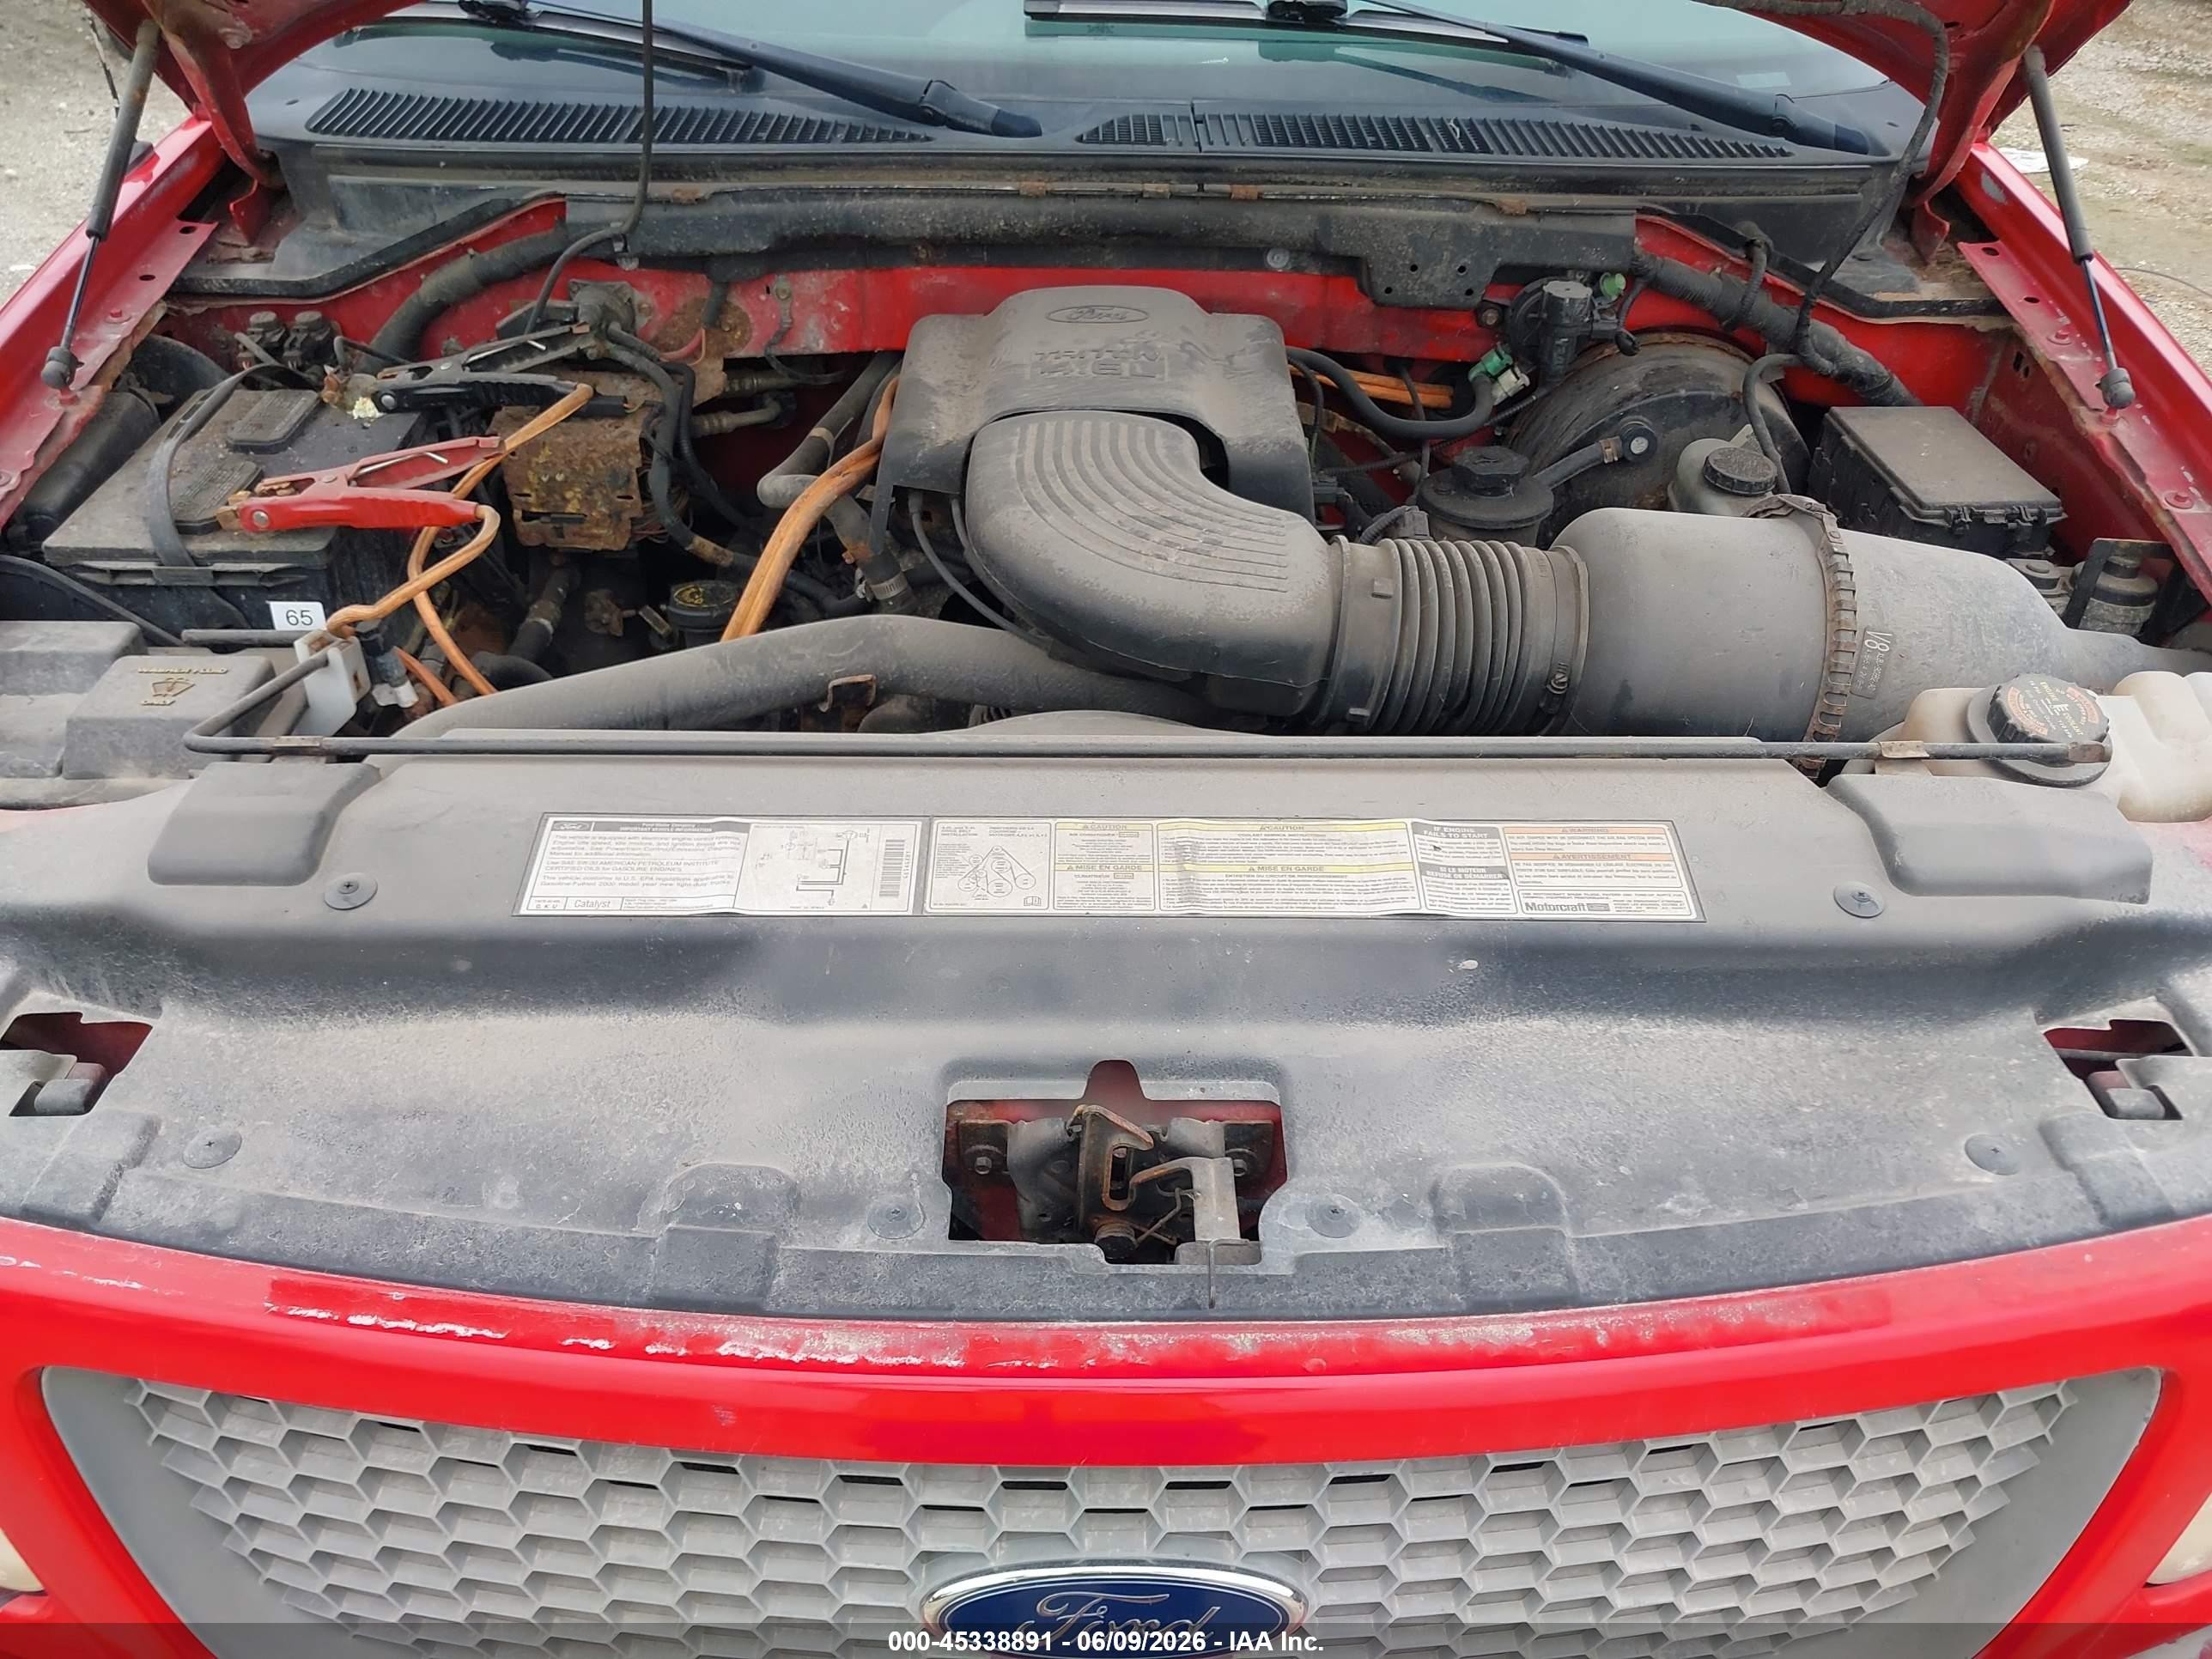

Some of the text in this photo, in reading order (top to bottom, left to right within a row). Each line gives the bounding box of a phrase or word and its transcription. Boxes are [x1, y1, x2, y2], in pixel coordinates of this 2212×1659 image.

[1066, 306, 1127, 320] Ford
[286, 610, 313, 626] 65
[1866, 630, 1893, 652] V8
[574, 899, 611, 909] Catalyst
[1524, 902, 1587, 912] Motorcraft
[1017, 1590, 1221, 1644] Ford
